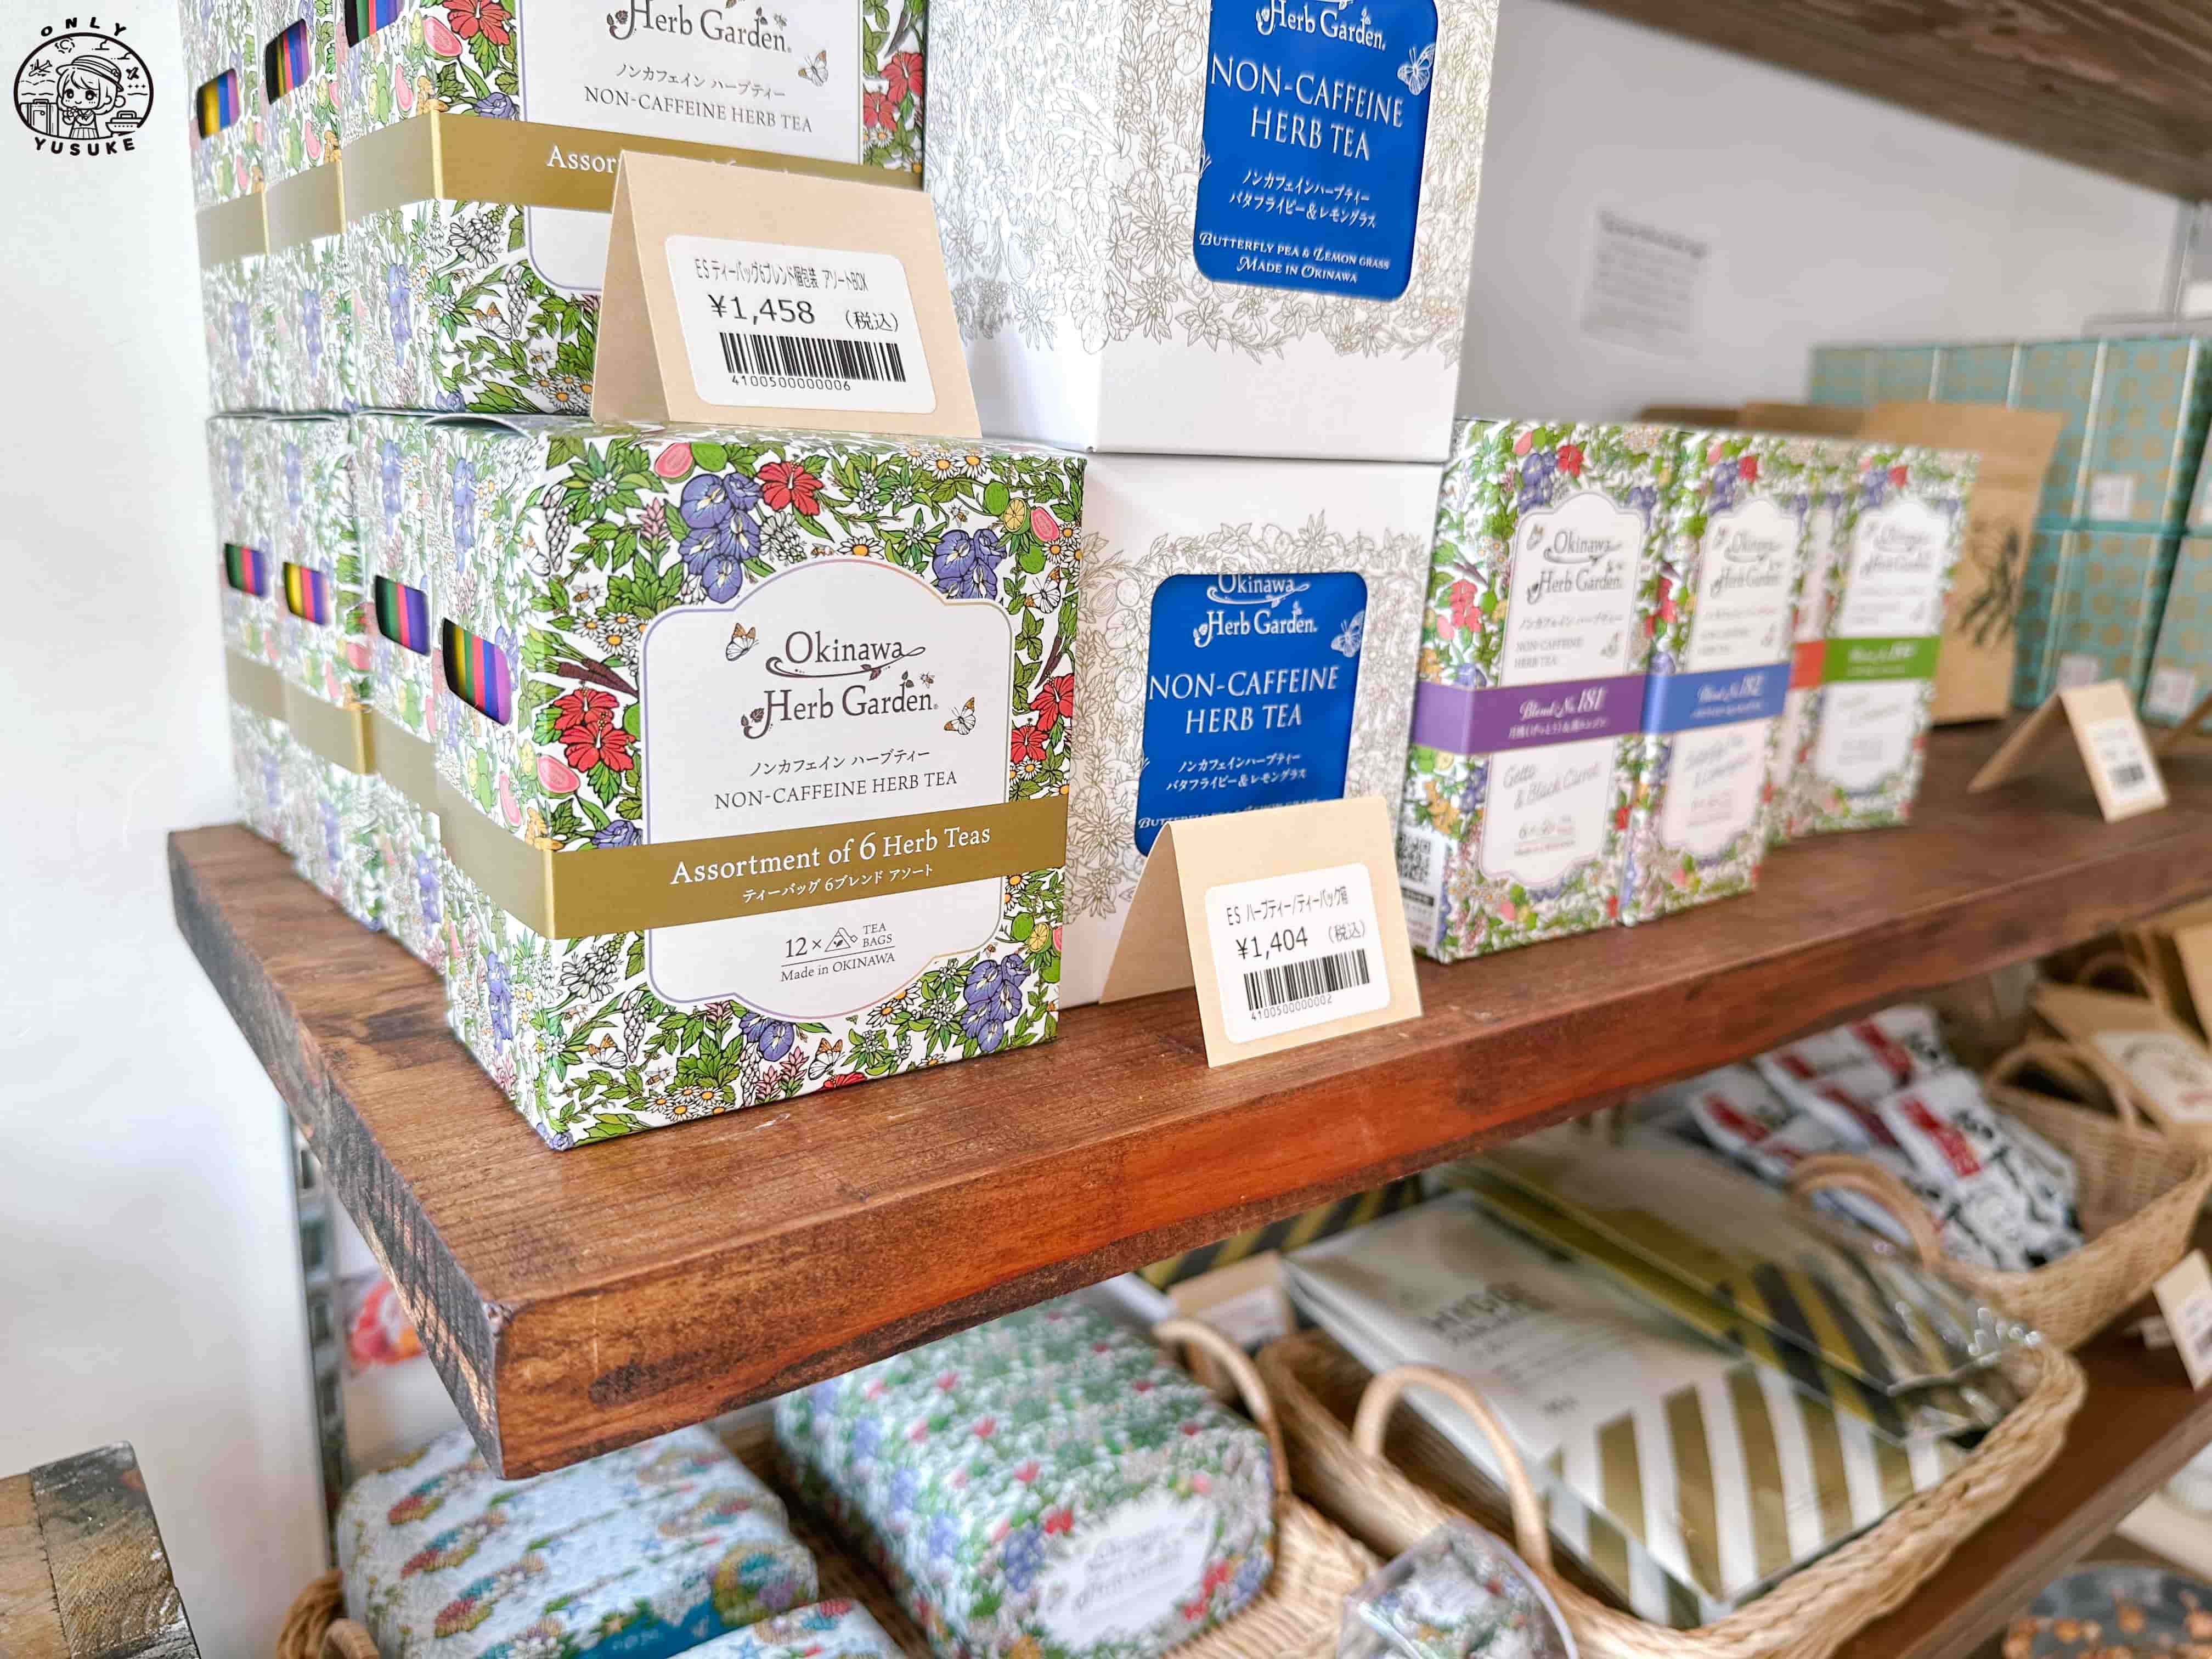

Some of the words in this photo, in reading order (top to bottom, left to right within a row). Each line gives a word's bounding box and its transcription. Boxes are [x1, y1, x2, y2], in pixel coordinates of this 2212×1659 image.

[607, 0, 692, 40] Herb
[701, 9, 787, 53] Garden
[1256, 0, 1316, 36] Herb
[1320, 8, 1384, 51] Garden
[616, 63, 706, 88] ノンカフェイン
[711, 79, 786, 100] ハーブティー
[1211, 52, 1404, 128] NON-CAFFEINE
[584, 87, 727, 120] NON-CAFFEINE
[732, 108, 776, 127] HERB
[781, 114, 812, 133] TEA
[1251, 104, 1322, 149] HERB
[1330, 122, 1369, 161] TEA
[546, 144, 617, 173] Assor
[695, 259, 710, 279] ES
[708, 295, 816, 325] ¥1,458
[732, 374, 851, 391] 4100500000006
[1193, 610, 1250, 648] Herb
[1254, 609, 1316, 635] Garden
[783, 630, 911, 665] Okinawa
[1149, 665, 1339, 700] NON-CAFFEINE
[741, 687, 833, 739] Herb
[842, 680, 934, 717] Garden
[1186, 706, 1253, 734] HERB
[1262, 703, 1302, 729] TEA
[749, 755, 846, 776] ノンカフェイン
[851, 748, 930, 769] ハーブティー
[715, 780, 867, 810] NON-CAFFEINE
[872, 774, 919, 793] HERB
[924, 770, 958, 788] TEA
[670, 847, 821, 885] Assortment
[828, 838, 853, 866] of
[859, 832, 876, 861] 6
[883, 829, 938, 858] Herb
[944, 826, 991, 849] Teas
[743, 878, 821, 904] ティーバッグ
[825, 870, 884, 893] 6ブレンド
[889, 864, 933, 882] アソート
[863, 922, 887, 934] TEA
[1227, 906, 1241, 926] ES
[862, 933, 893, 949] BAGS
[1235, 926, 1308, 960] ¥1,404
[781, 967, 815, 983] Made
[817, 964, 829, 977] in
[832, 952, 896, 972] OKINAWA
[1251, 994, 1333, 1022] 4100500000002
